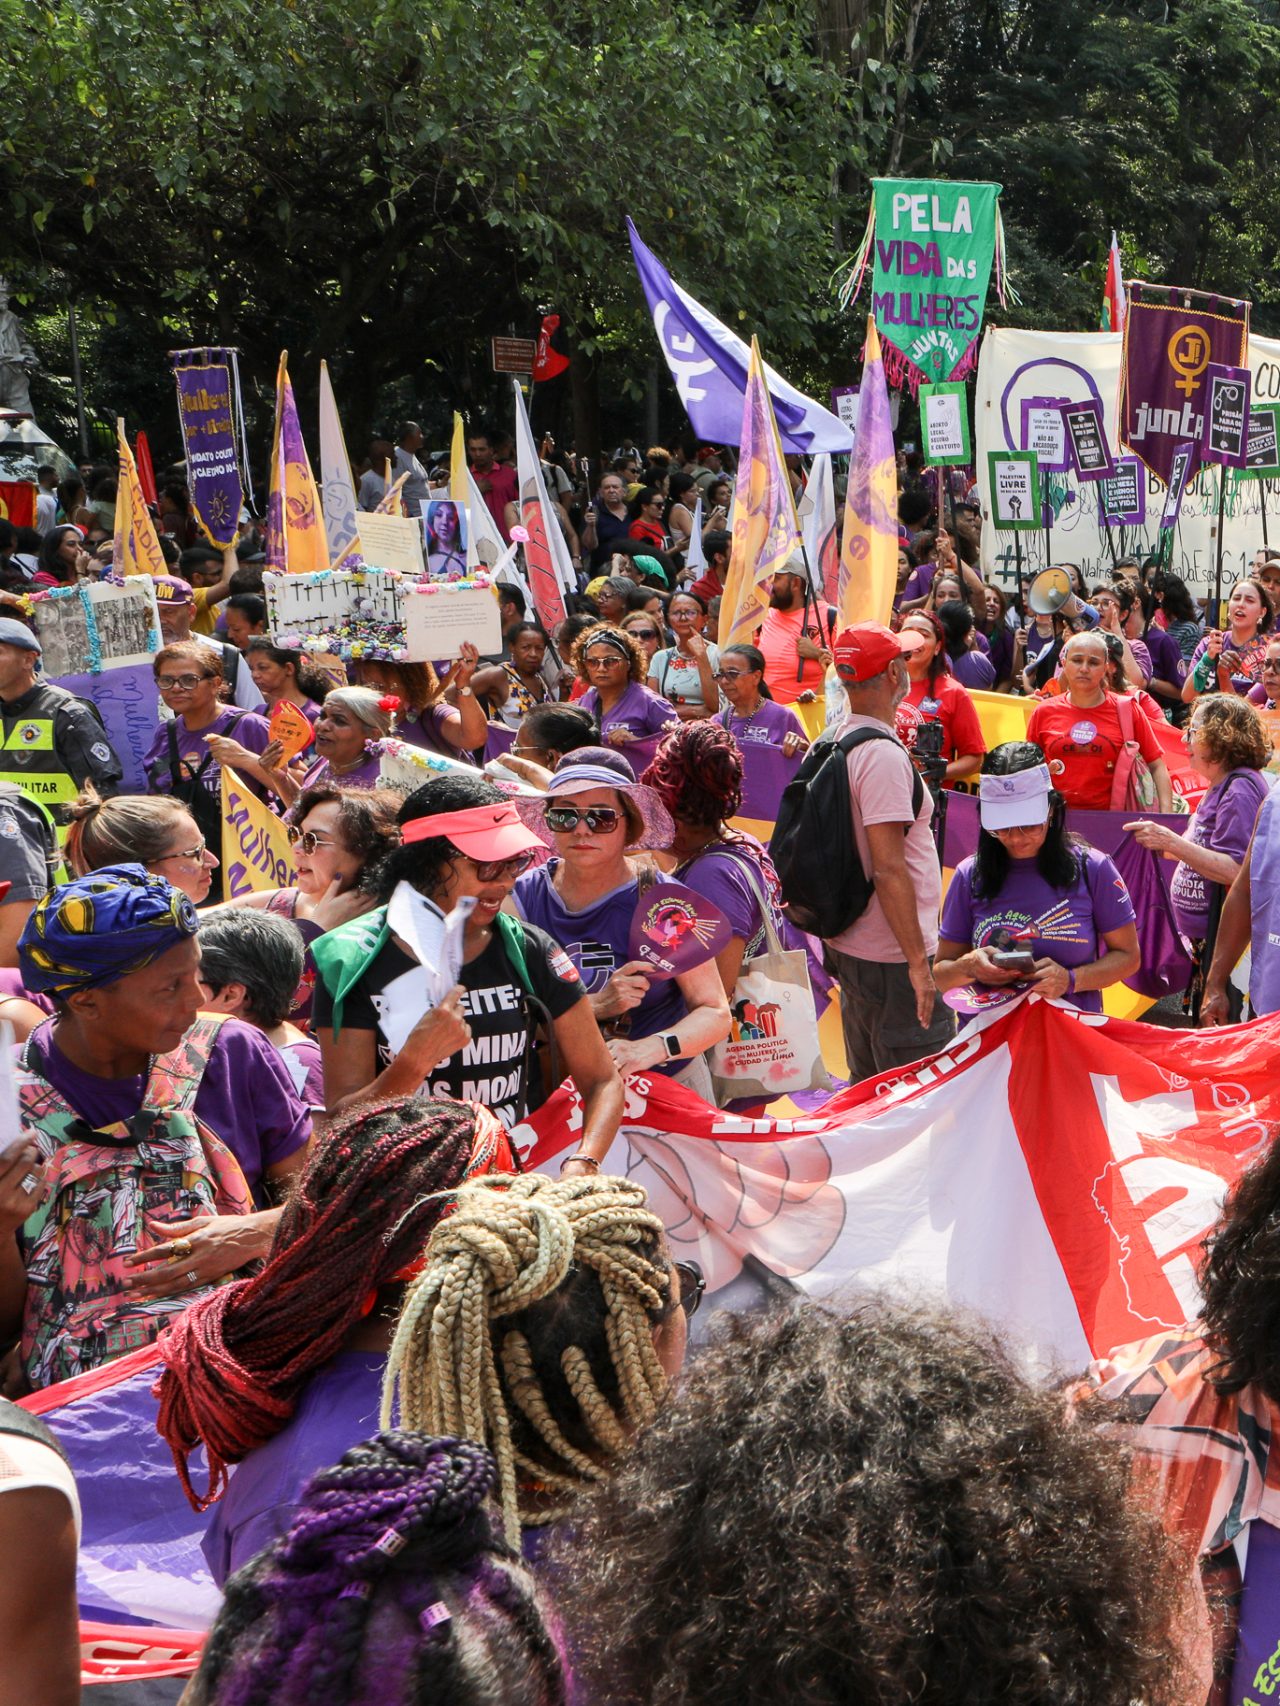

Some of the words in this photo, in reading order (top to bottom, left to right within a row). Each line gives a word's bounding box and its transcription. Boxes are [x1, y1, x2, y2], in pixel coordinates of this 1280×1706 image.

[892, 193, 973, 233] PELA
[876, 240, 943, 278] VIDA
[946, 256, 977, 279] DAS
[873, 292, 980, 331] MULHERES
[911, 330, 959, 362] JUNTAS
[1004, 909, 1033, 923] Aqui!
[726, 1044, 756, 1053] AGENDA
[746, 1049, 777, 1058] MUJERES
[735, 1057, 762, 1066] CIUDAD
